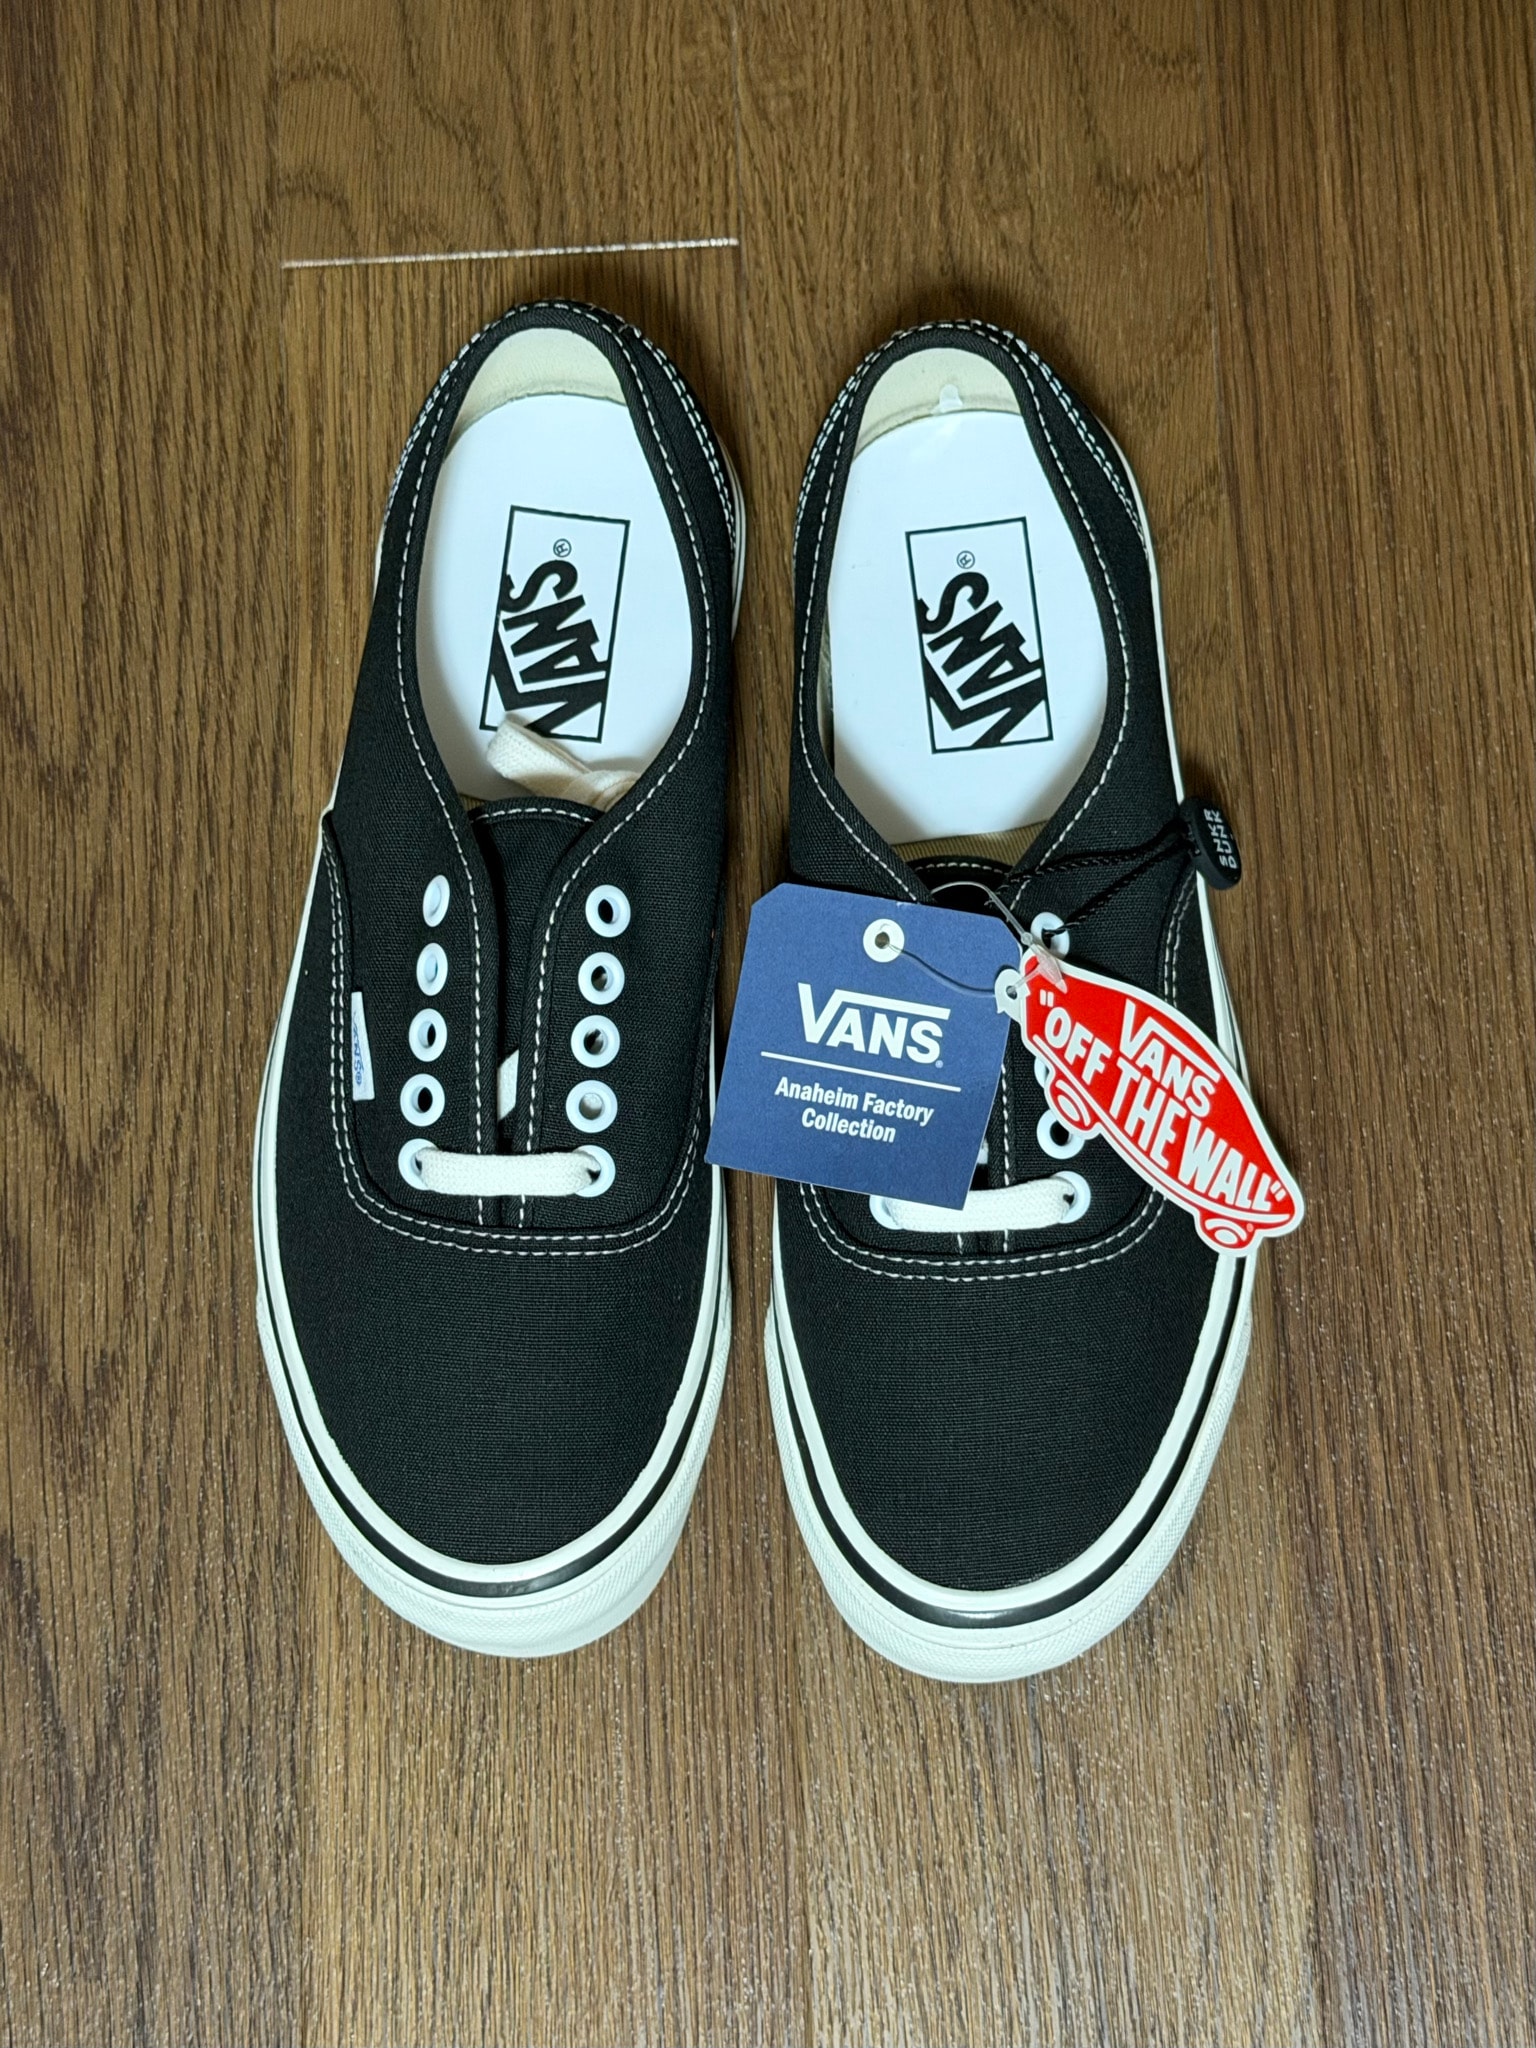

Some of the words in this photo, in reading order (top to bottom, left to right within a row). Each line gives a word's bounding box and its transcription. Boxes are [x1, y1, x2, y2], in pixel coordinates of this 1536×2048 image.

[490, 559, 609, 738] VANS
[914, 571, 1047, 749] VANS
[798, 982, 951, 1064] VANS
[1119, 998, 1220, 1118] VANS
[774, 1076, 858, 1110] Anaheim
[862, 1092, 934, 1127] Factory
[802, 1107, 896, 1143] Collection
[1108, 1056, 1187, 1170] THE
